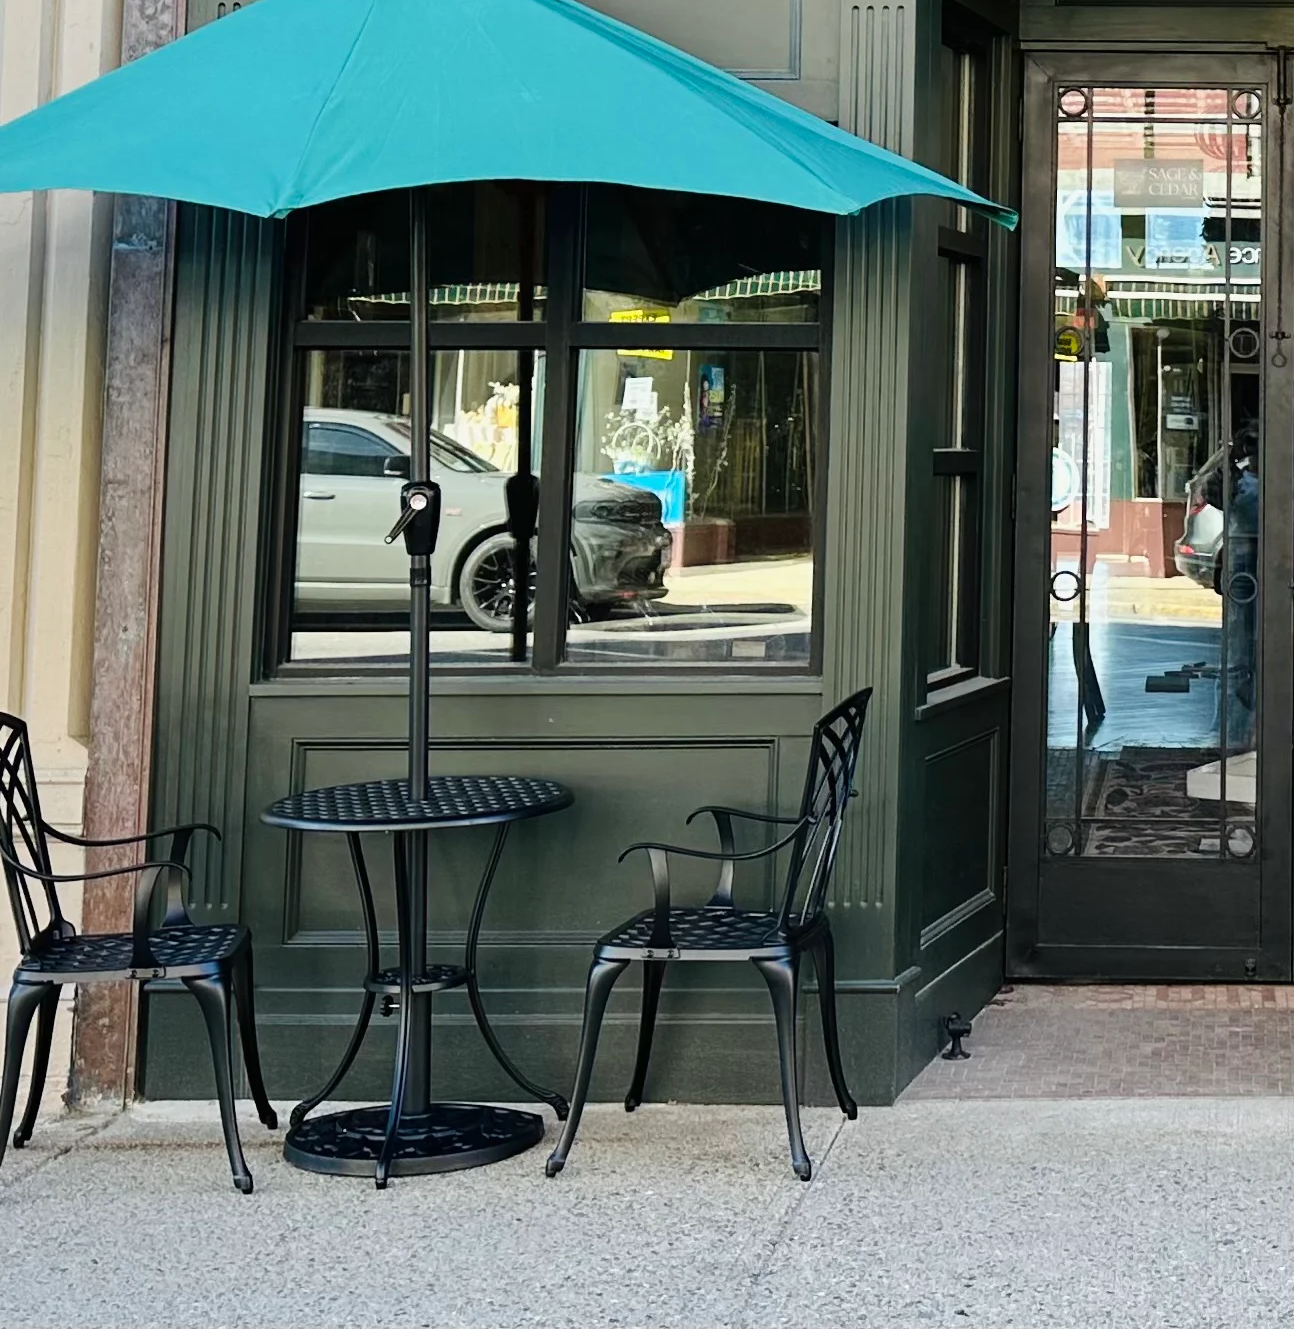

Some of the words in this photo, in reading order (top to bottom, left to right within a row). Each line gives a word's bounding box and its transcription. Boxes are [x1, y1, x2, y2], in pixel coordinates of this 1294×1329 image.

[1148, 167, 1185, 180] SAGE
[1188, 167, 1202, 180] &
[1148, 183, 1198, 196] CEDAR
